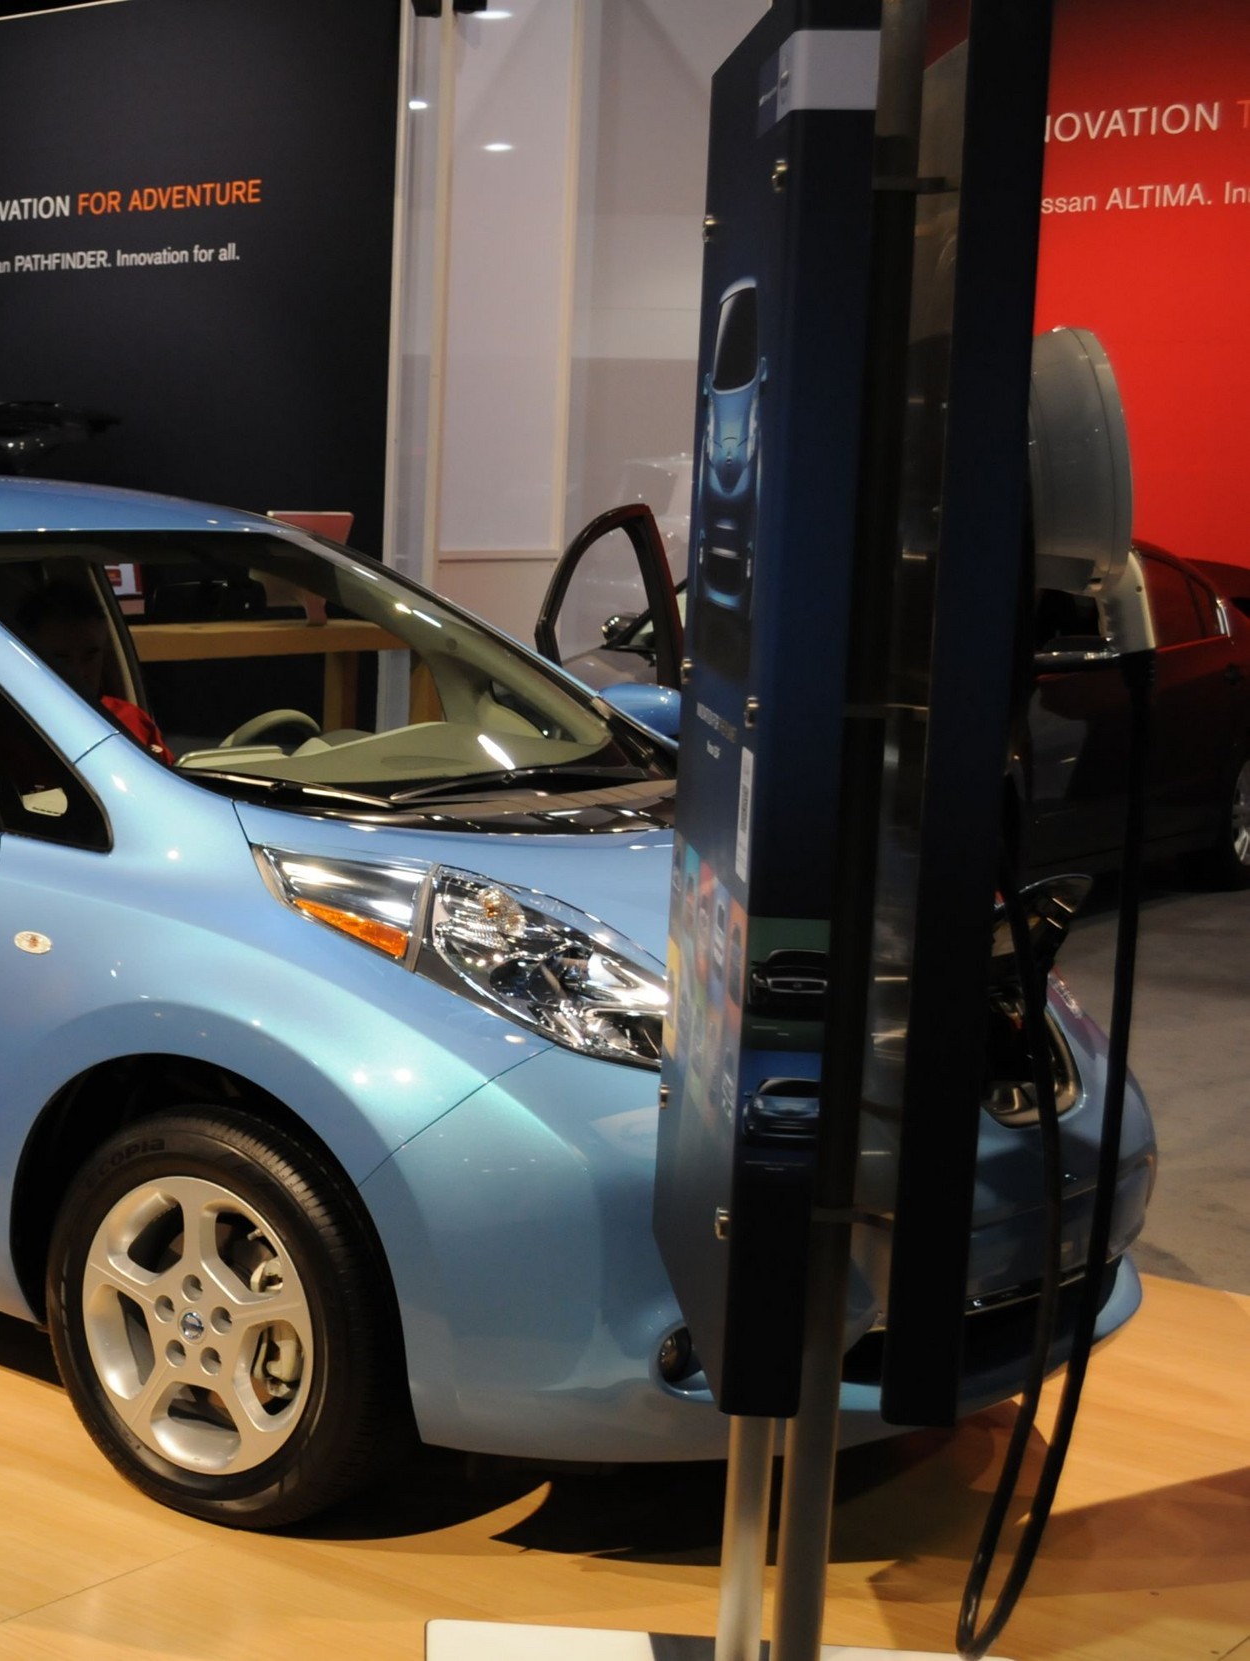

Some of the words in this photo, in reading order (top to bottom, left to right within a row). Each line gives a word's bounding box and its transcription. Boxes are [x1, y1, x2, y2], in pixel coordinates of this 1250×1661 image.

[77, 190, 122, 216] FOR
[128, 179, 262, 212] ADVENTURE
[1105, 183, 1213, 210] ALTIMA.
[14, 250, 112, 273] PATHFINDER.
[116, 246, 189, 267] Innovation
[193, 244, 214, 262] for
[218, 242, 240, 261] all.
